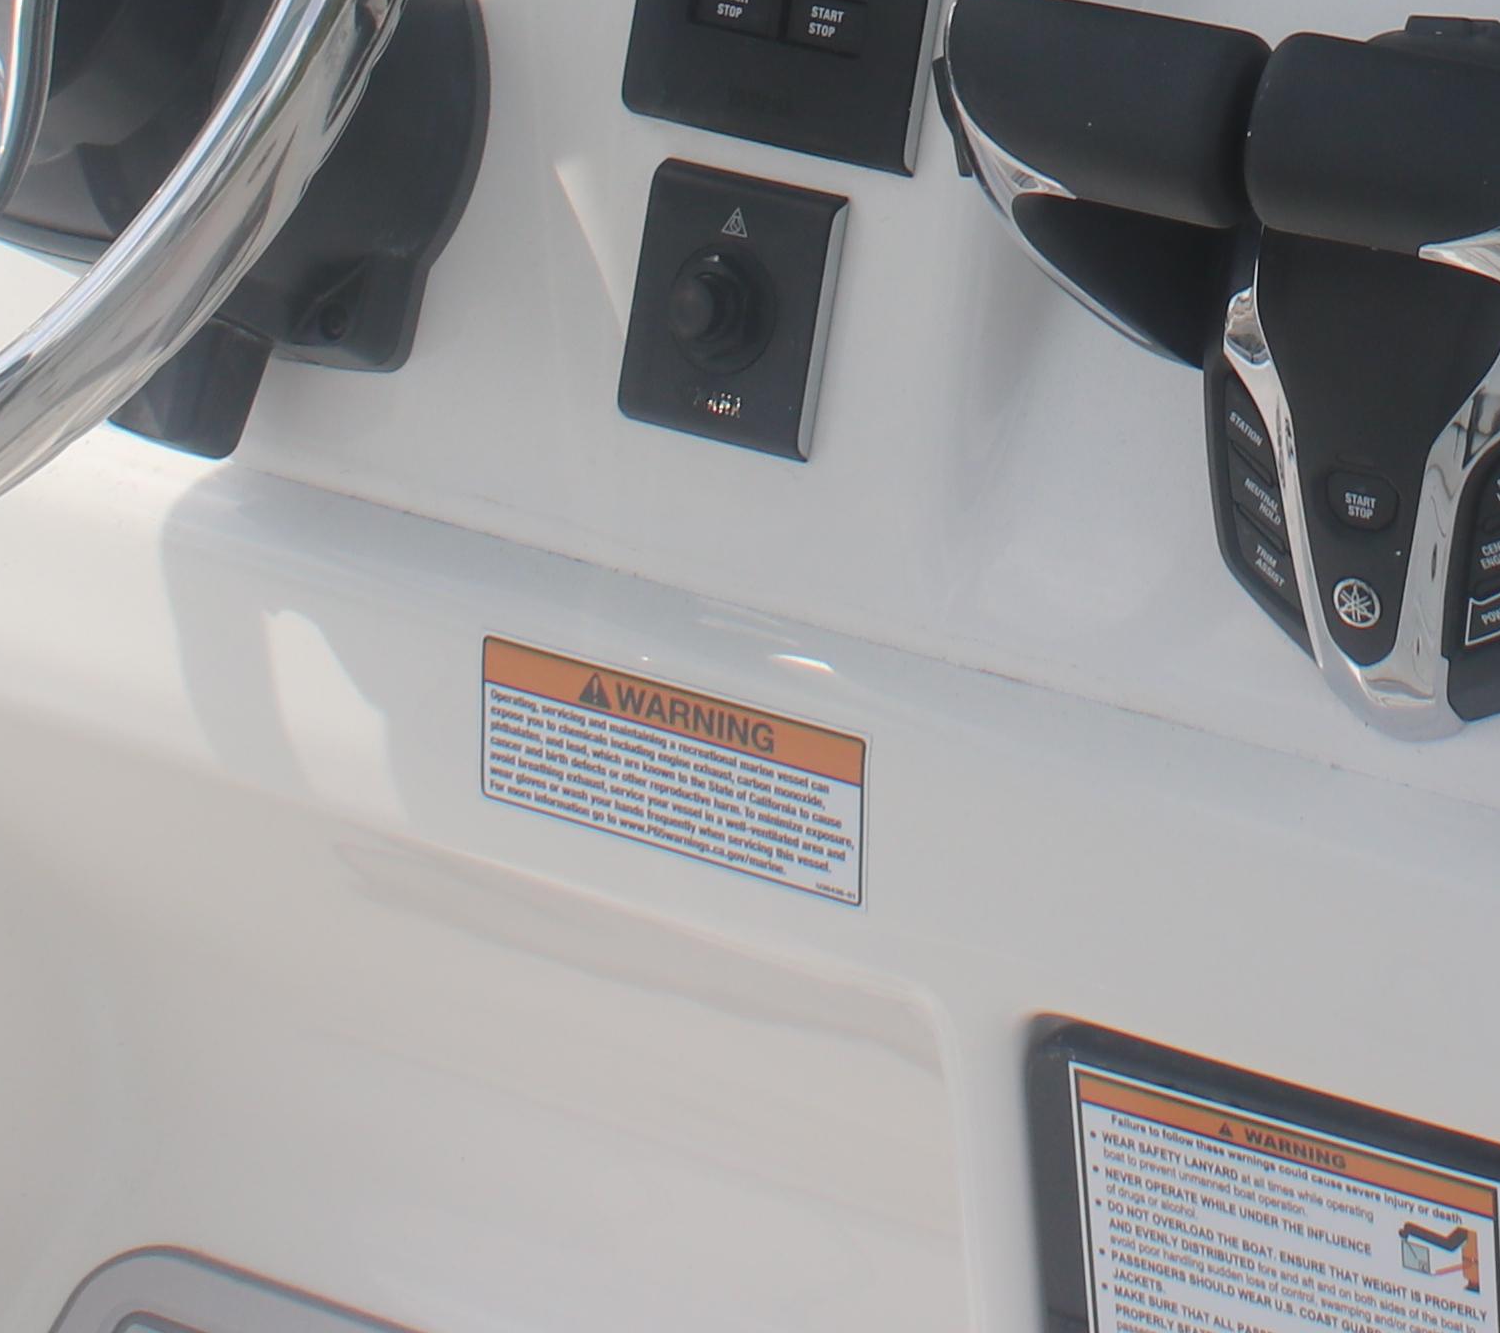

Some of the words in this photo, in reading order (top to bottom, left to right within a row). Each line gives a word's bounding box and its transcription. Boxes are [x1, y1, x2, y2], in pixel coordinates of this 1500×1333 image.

[717, 2, 743, 19] STOP
[811, 5, 844, 23] START
[808, 21, 836, 38] STOP
[1229, 411, 1262, 447] STATION
[1244, 478, 1281, 512] NEUTRAL
[1344, 491, 1376, 509] START
[1258, 500, 1281, 526] HOLD
[1347, 505, 1374, 520] STOP
[1255, 544, 1278, 568] TRIM
[1254, 558, 1285, 588] ASSIST
[615, 681, 774, 754] WARNING
[1243, 1127, 1346, 1169] WARNING
